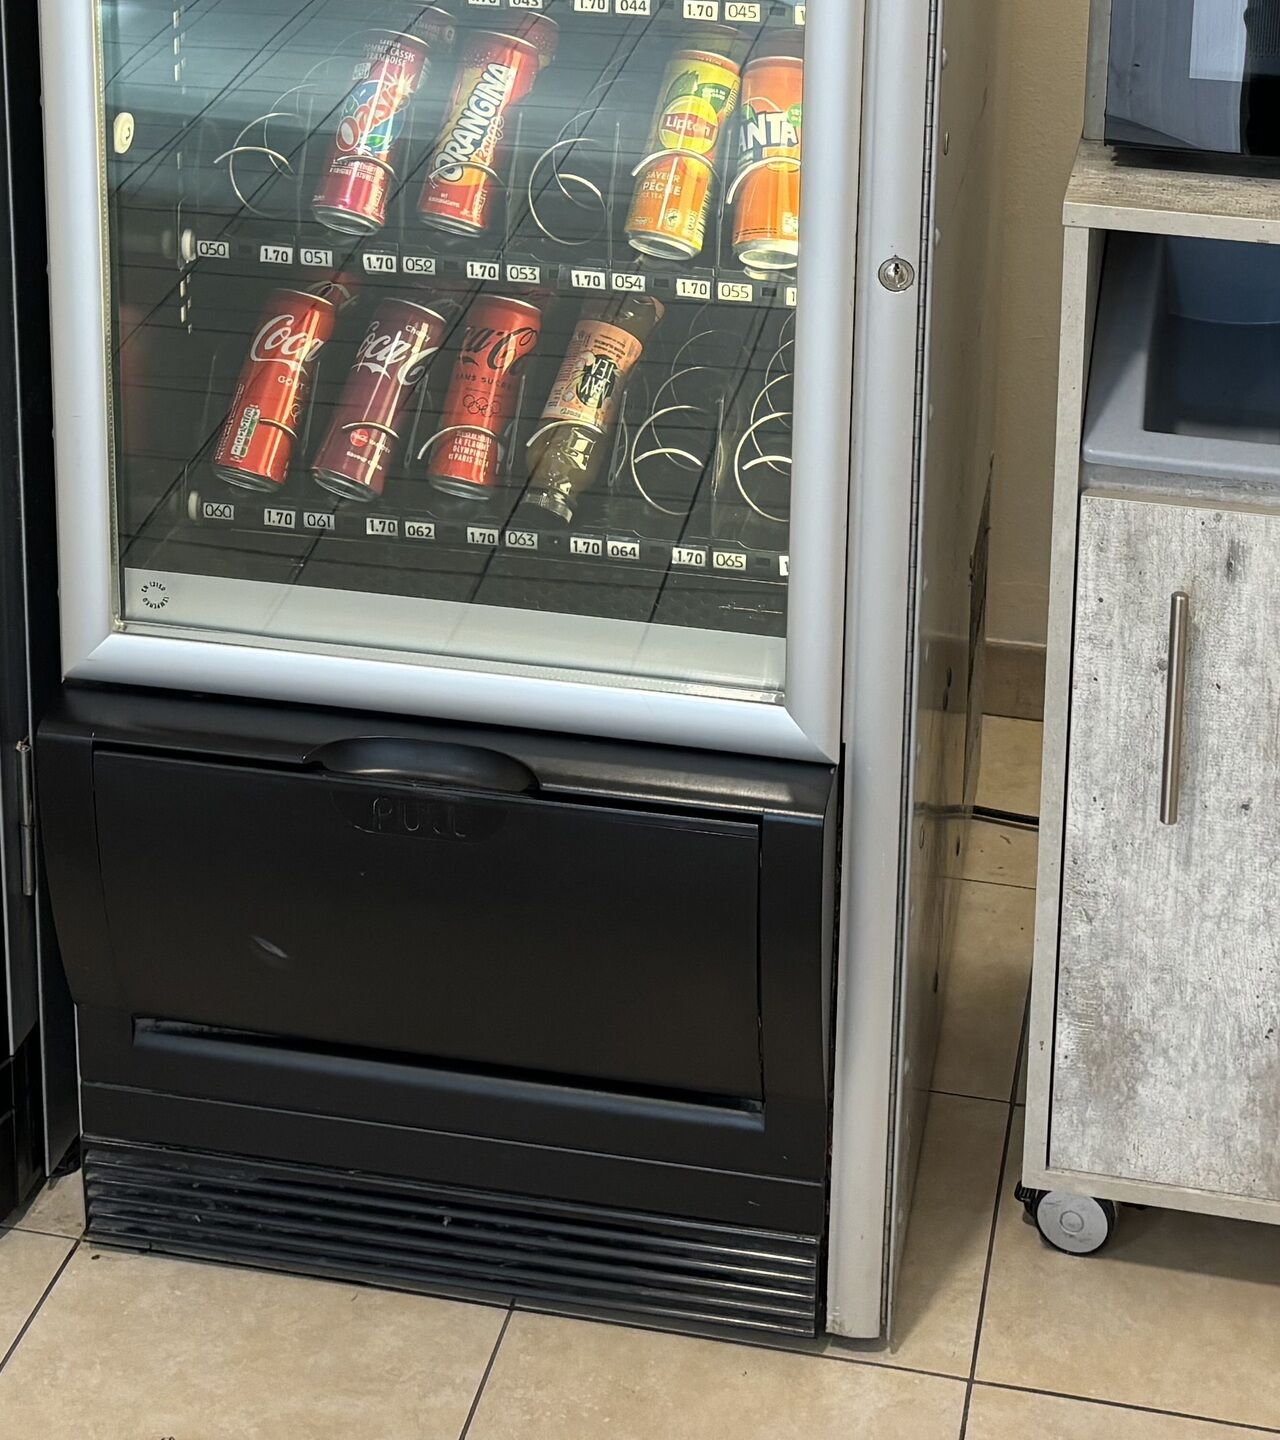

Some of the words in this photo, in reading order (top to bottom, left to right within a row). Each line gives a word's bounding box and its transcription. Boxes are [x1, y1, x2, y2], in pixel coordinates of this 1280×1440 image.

[433, 62, 512, 183] ORANGINA
[665, 114, 711, 139] Lipton
[204, 504, 232, 518] 060
[268, 511, 293, 526] 1.70
[306, 514, 332, 529] 061
[370, 520, 396, 534] 1.70
[408, 525, 433, 538] 062
